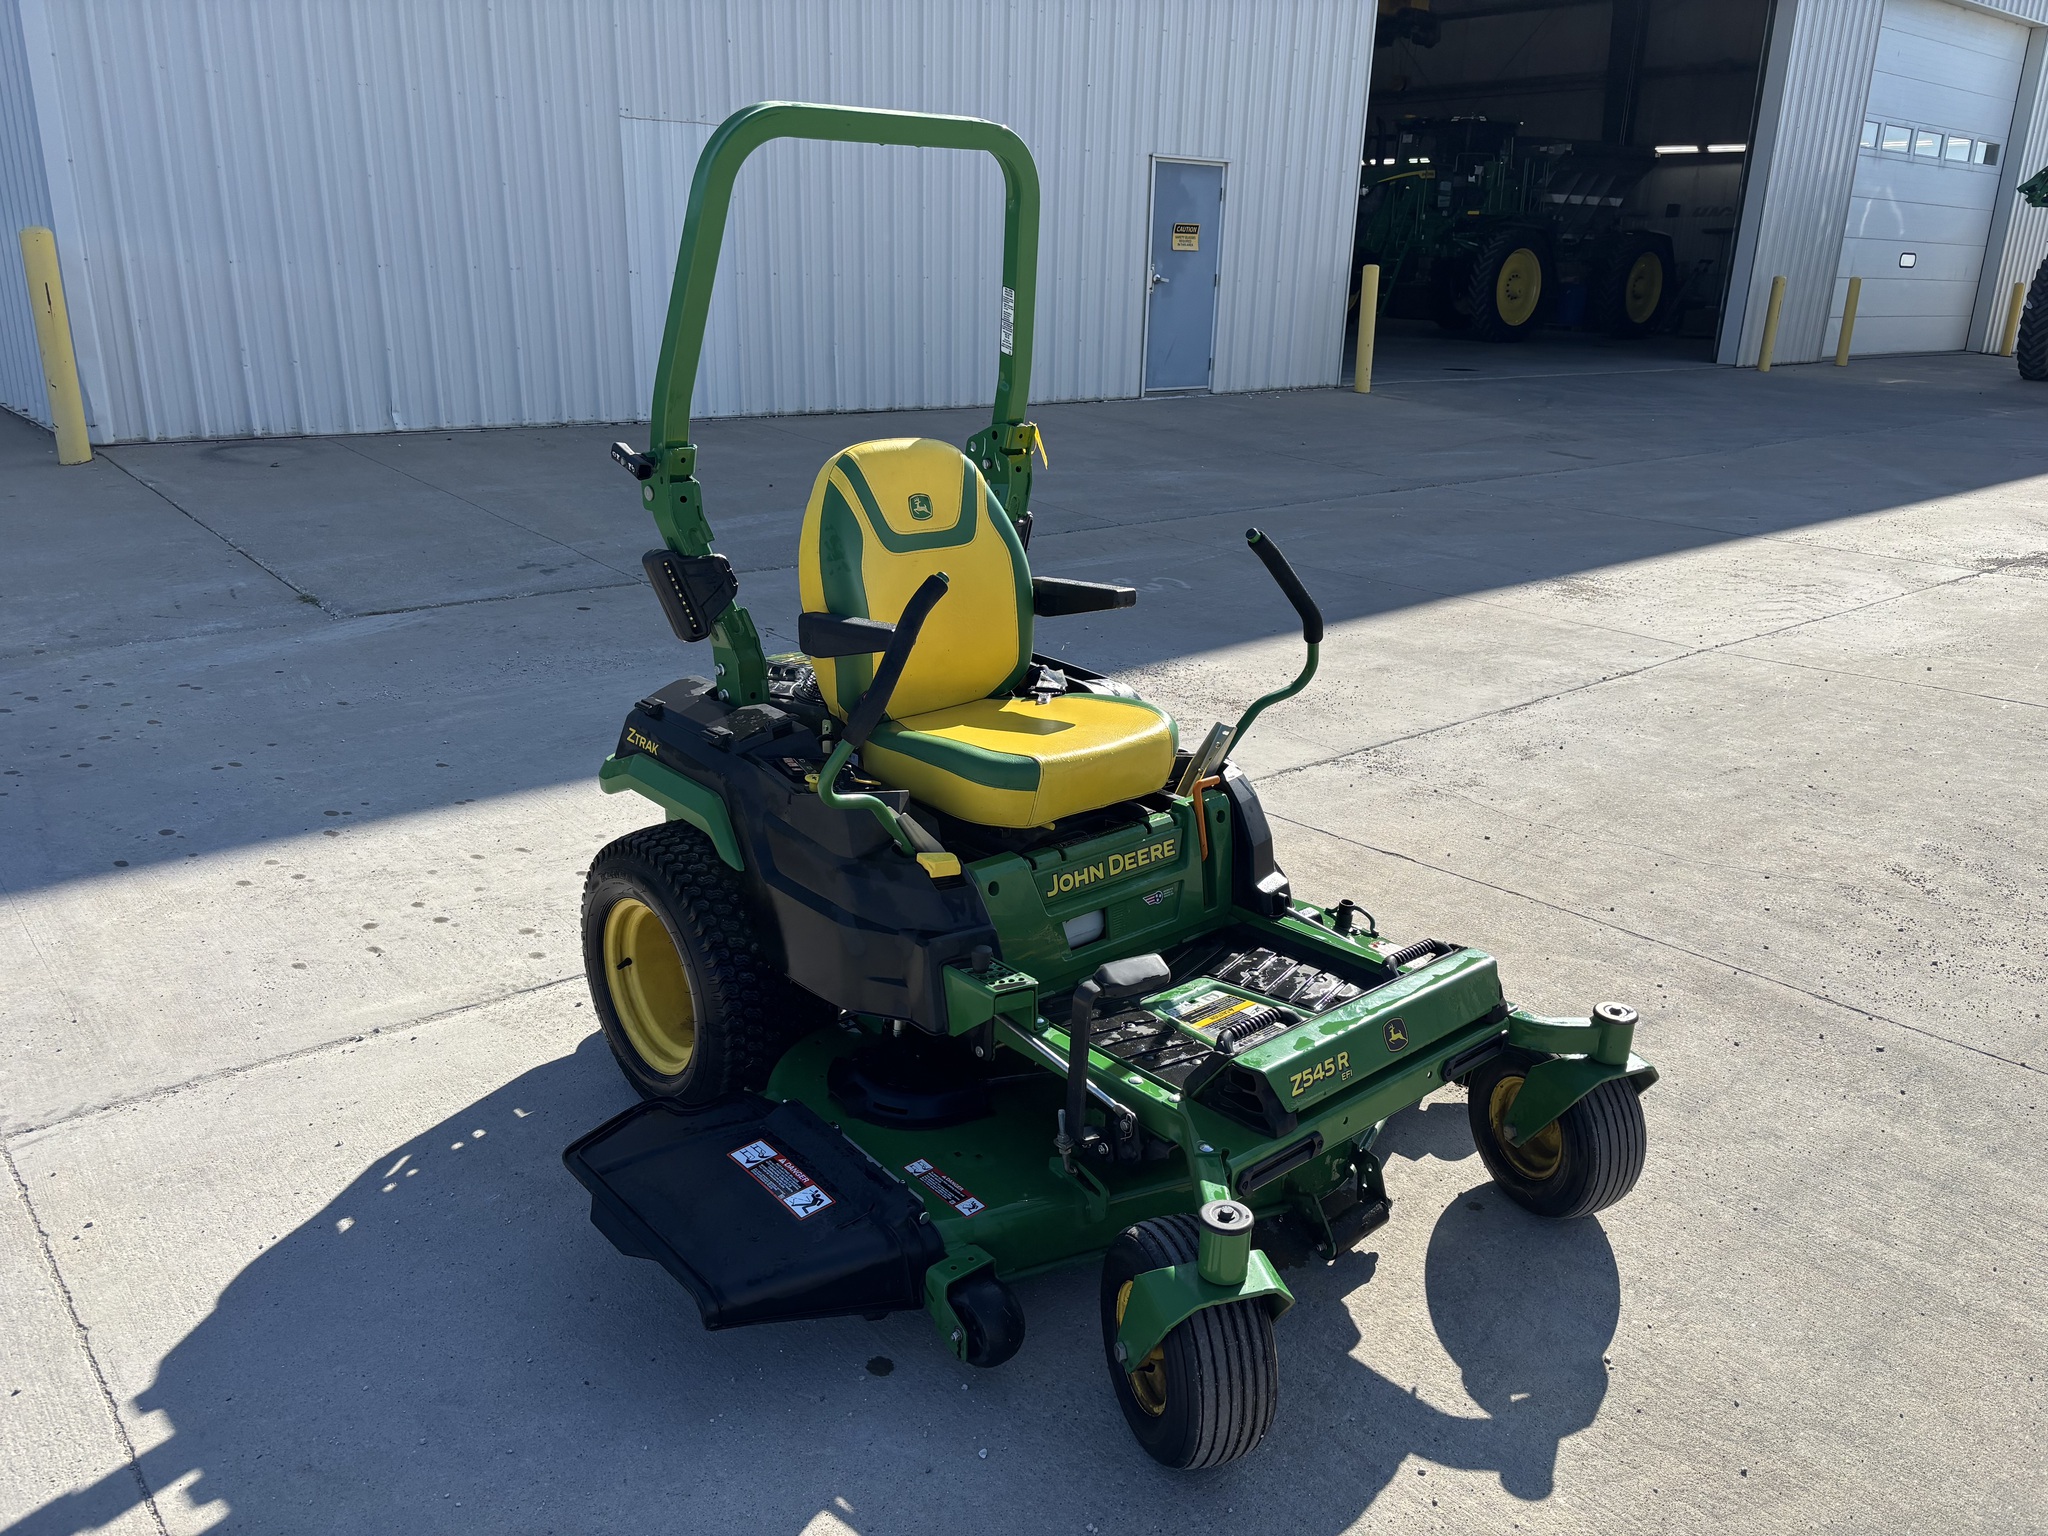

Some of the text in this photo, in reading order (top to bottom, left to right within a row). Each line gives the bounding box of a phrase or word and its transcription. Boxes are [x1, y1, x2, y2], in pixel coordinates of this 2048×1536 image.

[626, 727, 659, 756] ZTRAK
[1047, 838, 1176, 897] JOHN DEERE
[1290, 1051, 1349, 1097] Z545 R
[1341, 1069, 1353, 1081] EFI
[784, 1162, 810, 1183] DANGER
